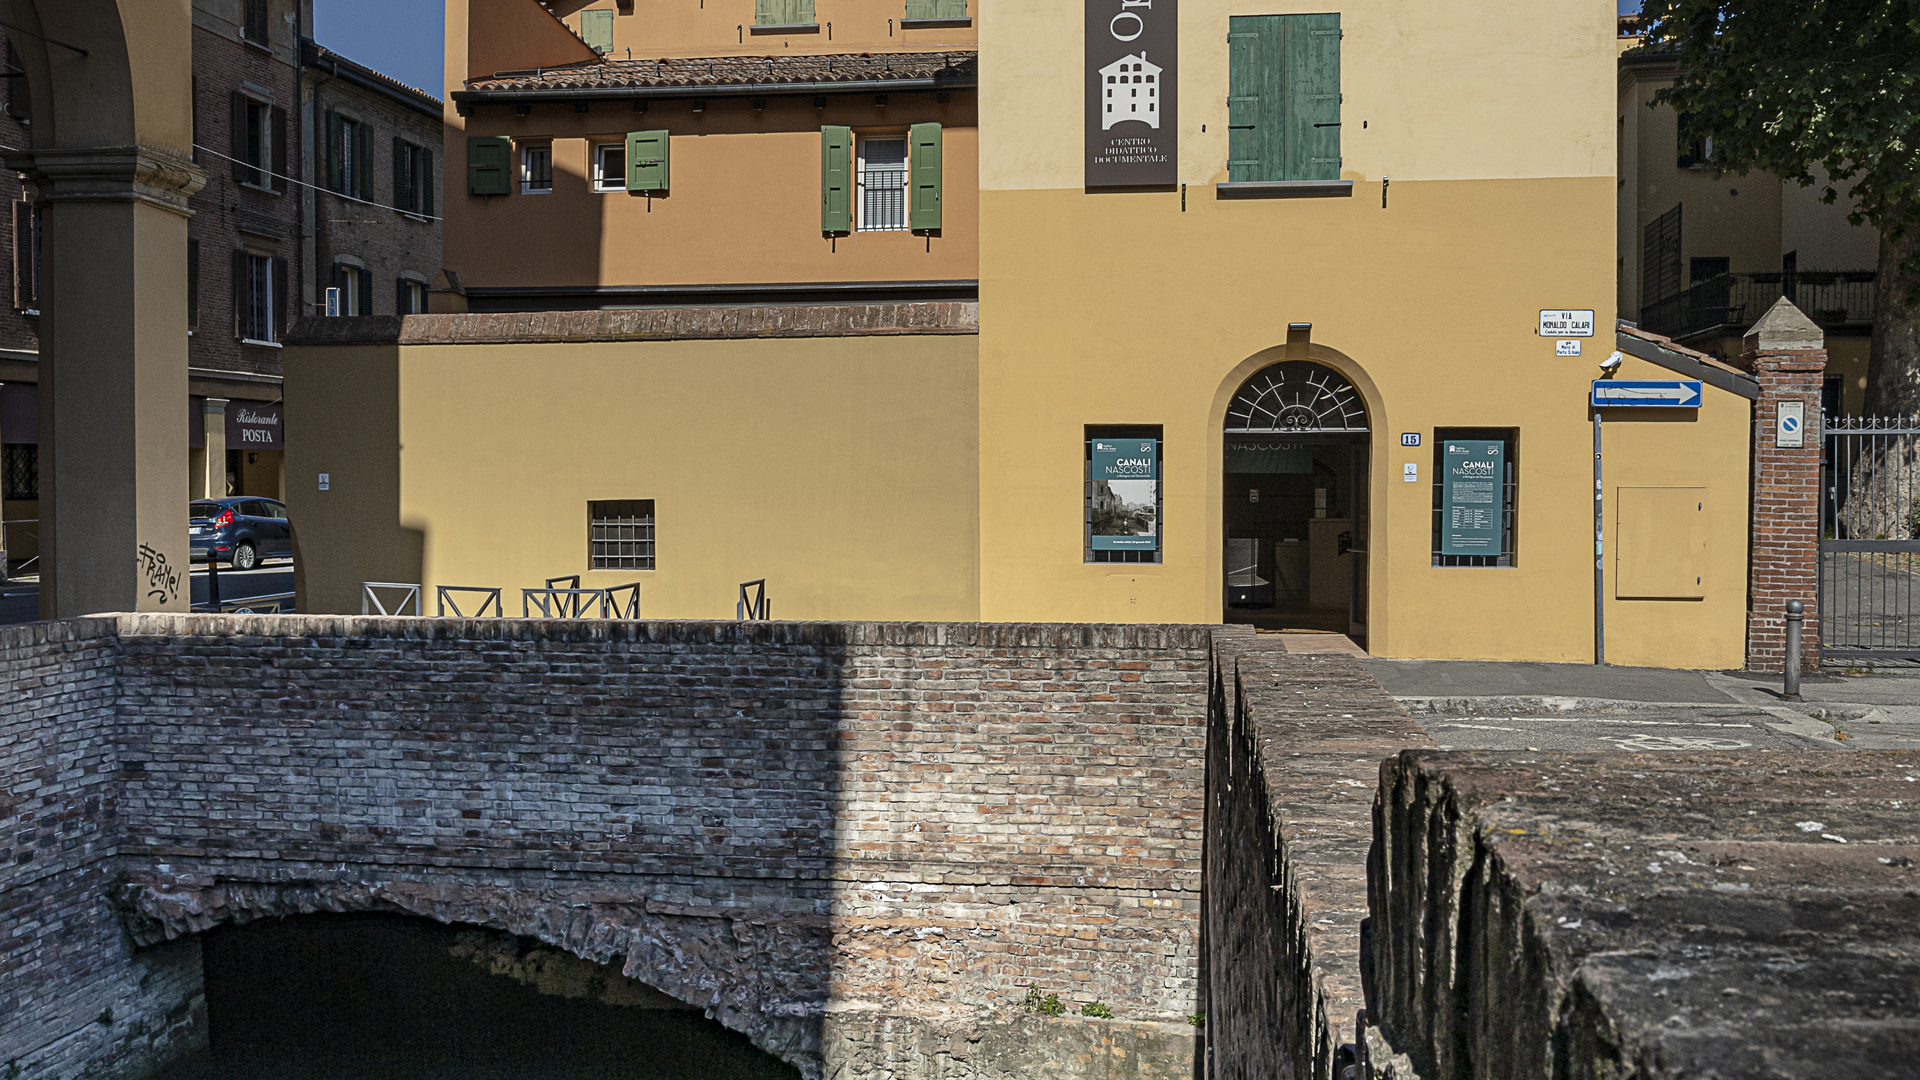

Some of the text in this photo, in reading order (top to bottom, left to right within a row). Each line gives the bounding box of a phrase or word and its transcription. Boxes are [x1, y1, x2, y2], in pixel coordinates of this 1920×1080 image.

[1094, 155, 1168, 163] DOCUMENTALE
[1561, 312, 1572, 320] VIA
[236, 409, 279, 426] Ristorante
[242, 429, 273, 442] POSTA
[1405, 435, 1417, 444] 15
[1116, 458, 1151, 466] CANALI
[1462, 461, 1494, 469] CANALI
[1105, 466, 1151, 474] NASCOSTI
